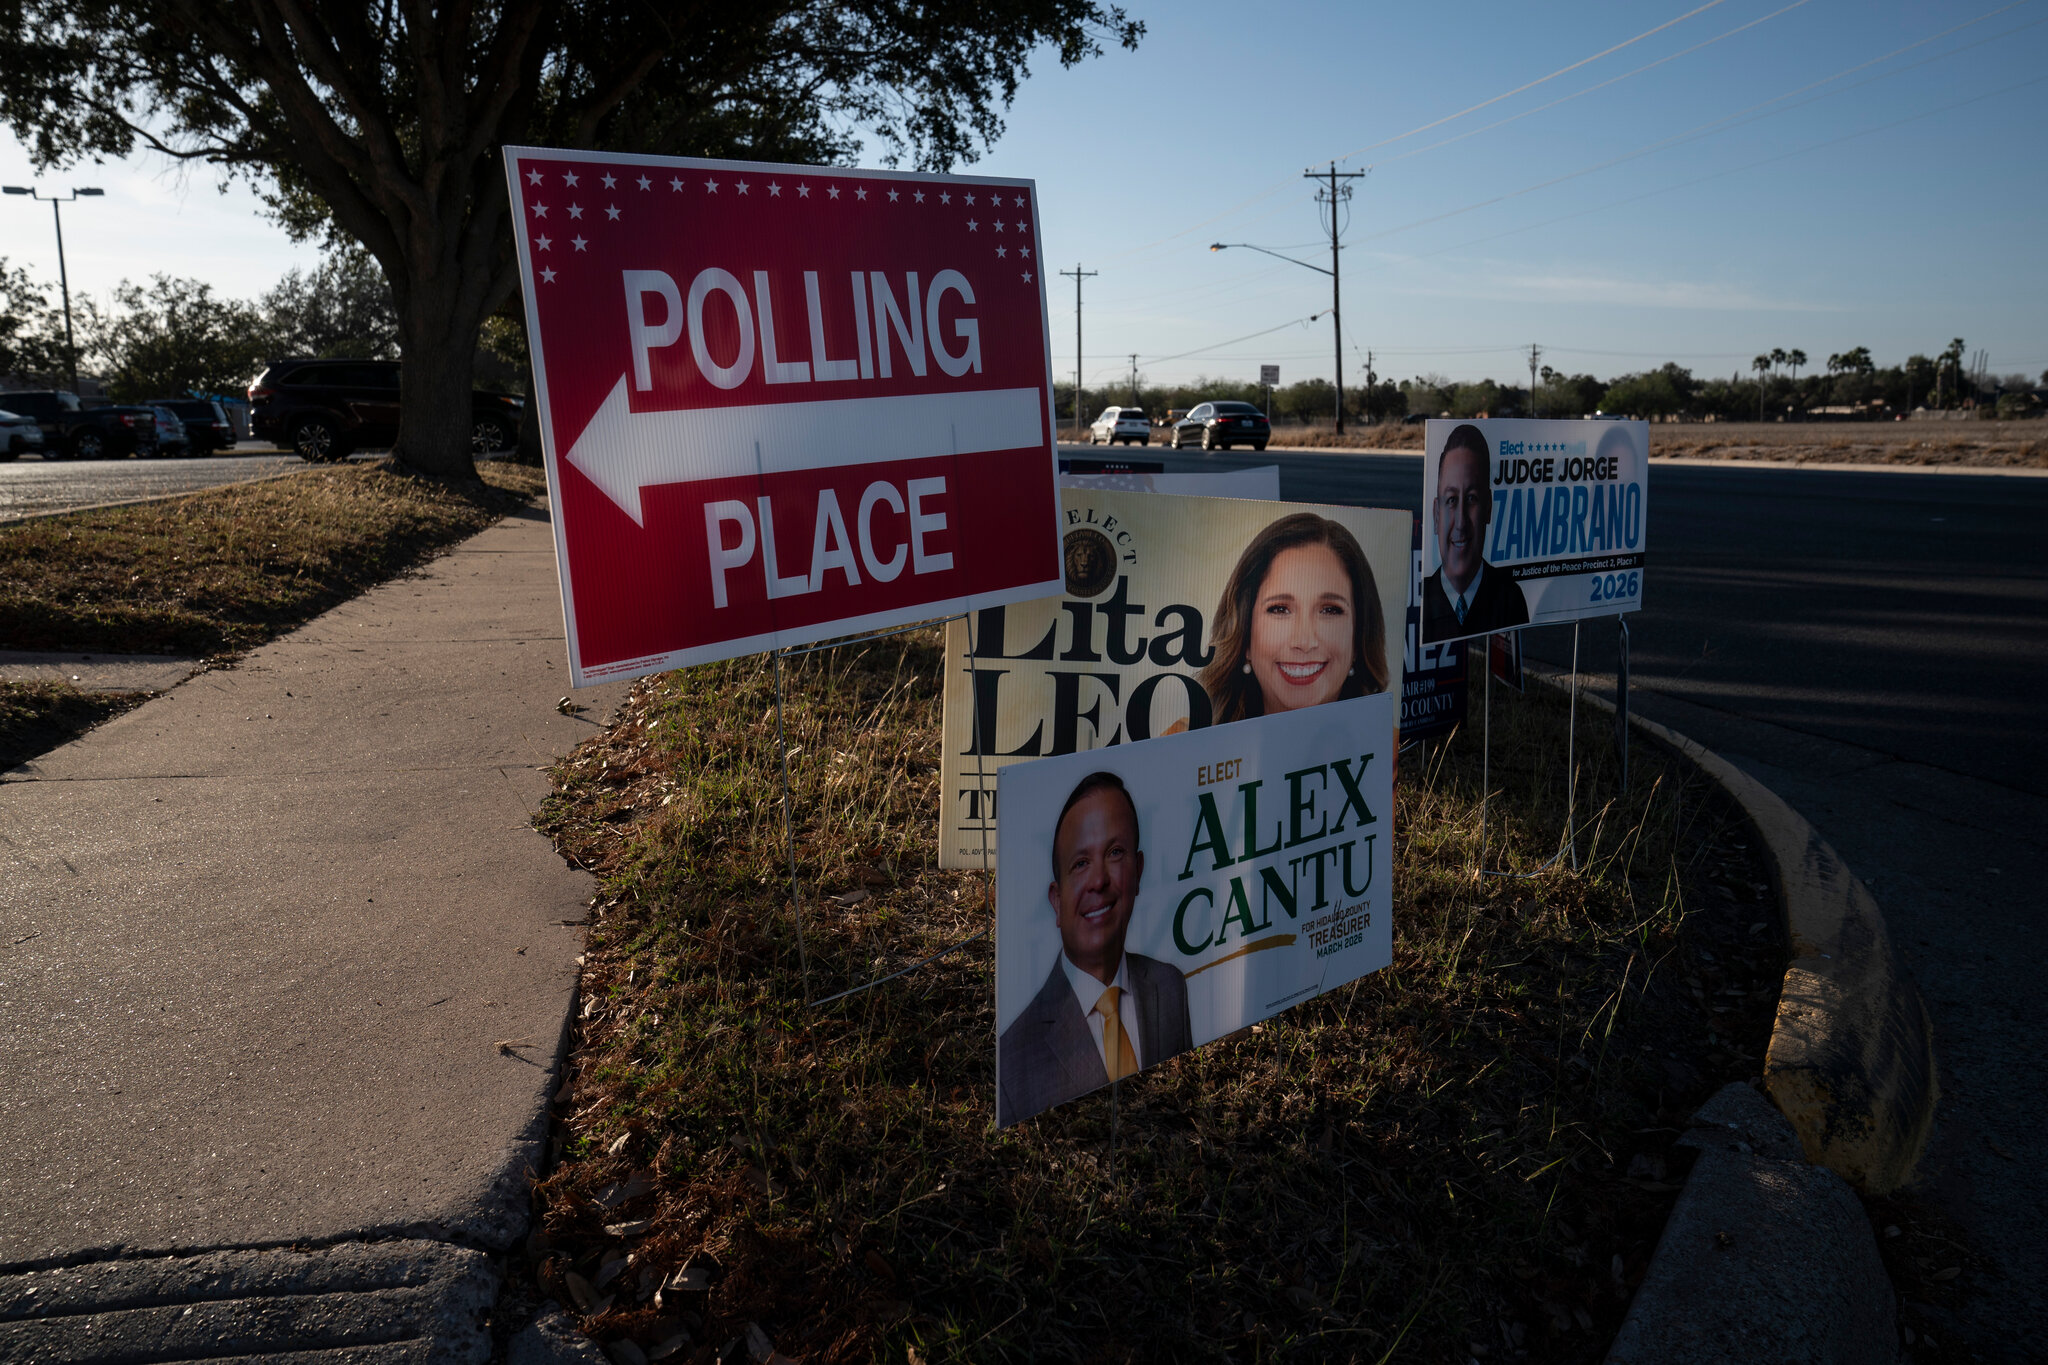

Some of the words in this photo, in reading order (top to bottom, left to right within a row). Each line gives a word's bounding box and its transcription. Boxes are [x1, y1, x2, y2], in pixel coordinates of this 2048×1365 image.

[622, 267, 983, 392] POLLING
[1500, 440, 1524, 456] Elect
[1494, 458, 1554, 486] JUDGE
[1559, 457, 1619, 484] JORGE
[1066, 508, 1137, 564] ELECT
[1490, 482, 1641, 563] ZAMBRANO
[703, 475, 954, 609] PLACE
[1521, 566, 1542, 577] Justice
[1543, 564, 1550, 574] of
[1551, 563, 1560, 573] the
[1561, 561, 1582, 572] Peace
[1583, 559, 1609, 571] Precinct
[1618, 557, 1633, 567] Place
[1590, 572, 1639, 602] 2026
[963, 574, 1216, 667] Lita
[960, 668, 1213, 756] LEO
[1411, 697, 1455, 719] COUNTY
[1198, 758, 1243, 787] ELECT
[1178, 753, 1377, 882] ALEX
[1172, 833, 1377, 956] CANTU
[1301, 920, 1315, 934] FOR
[1345, 900, 1371, 918] COUNTY
[1308, 913, 1371, 950] TREASURER
[1316, 940, 1343, 960] MARCH
[1344, 932, 1363, 949] 2026
